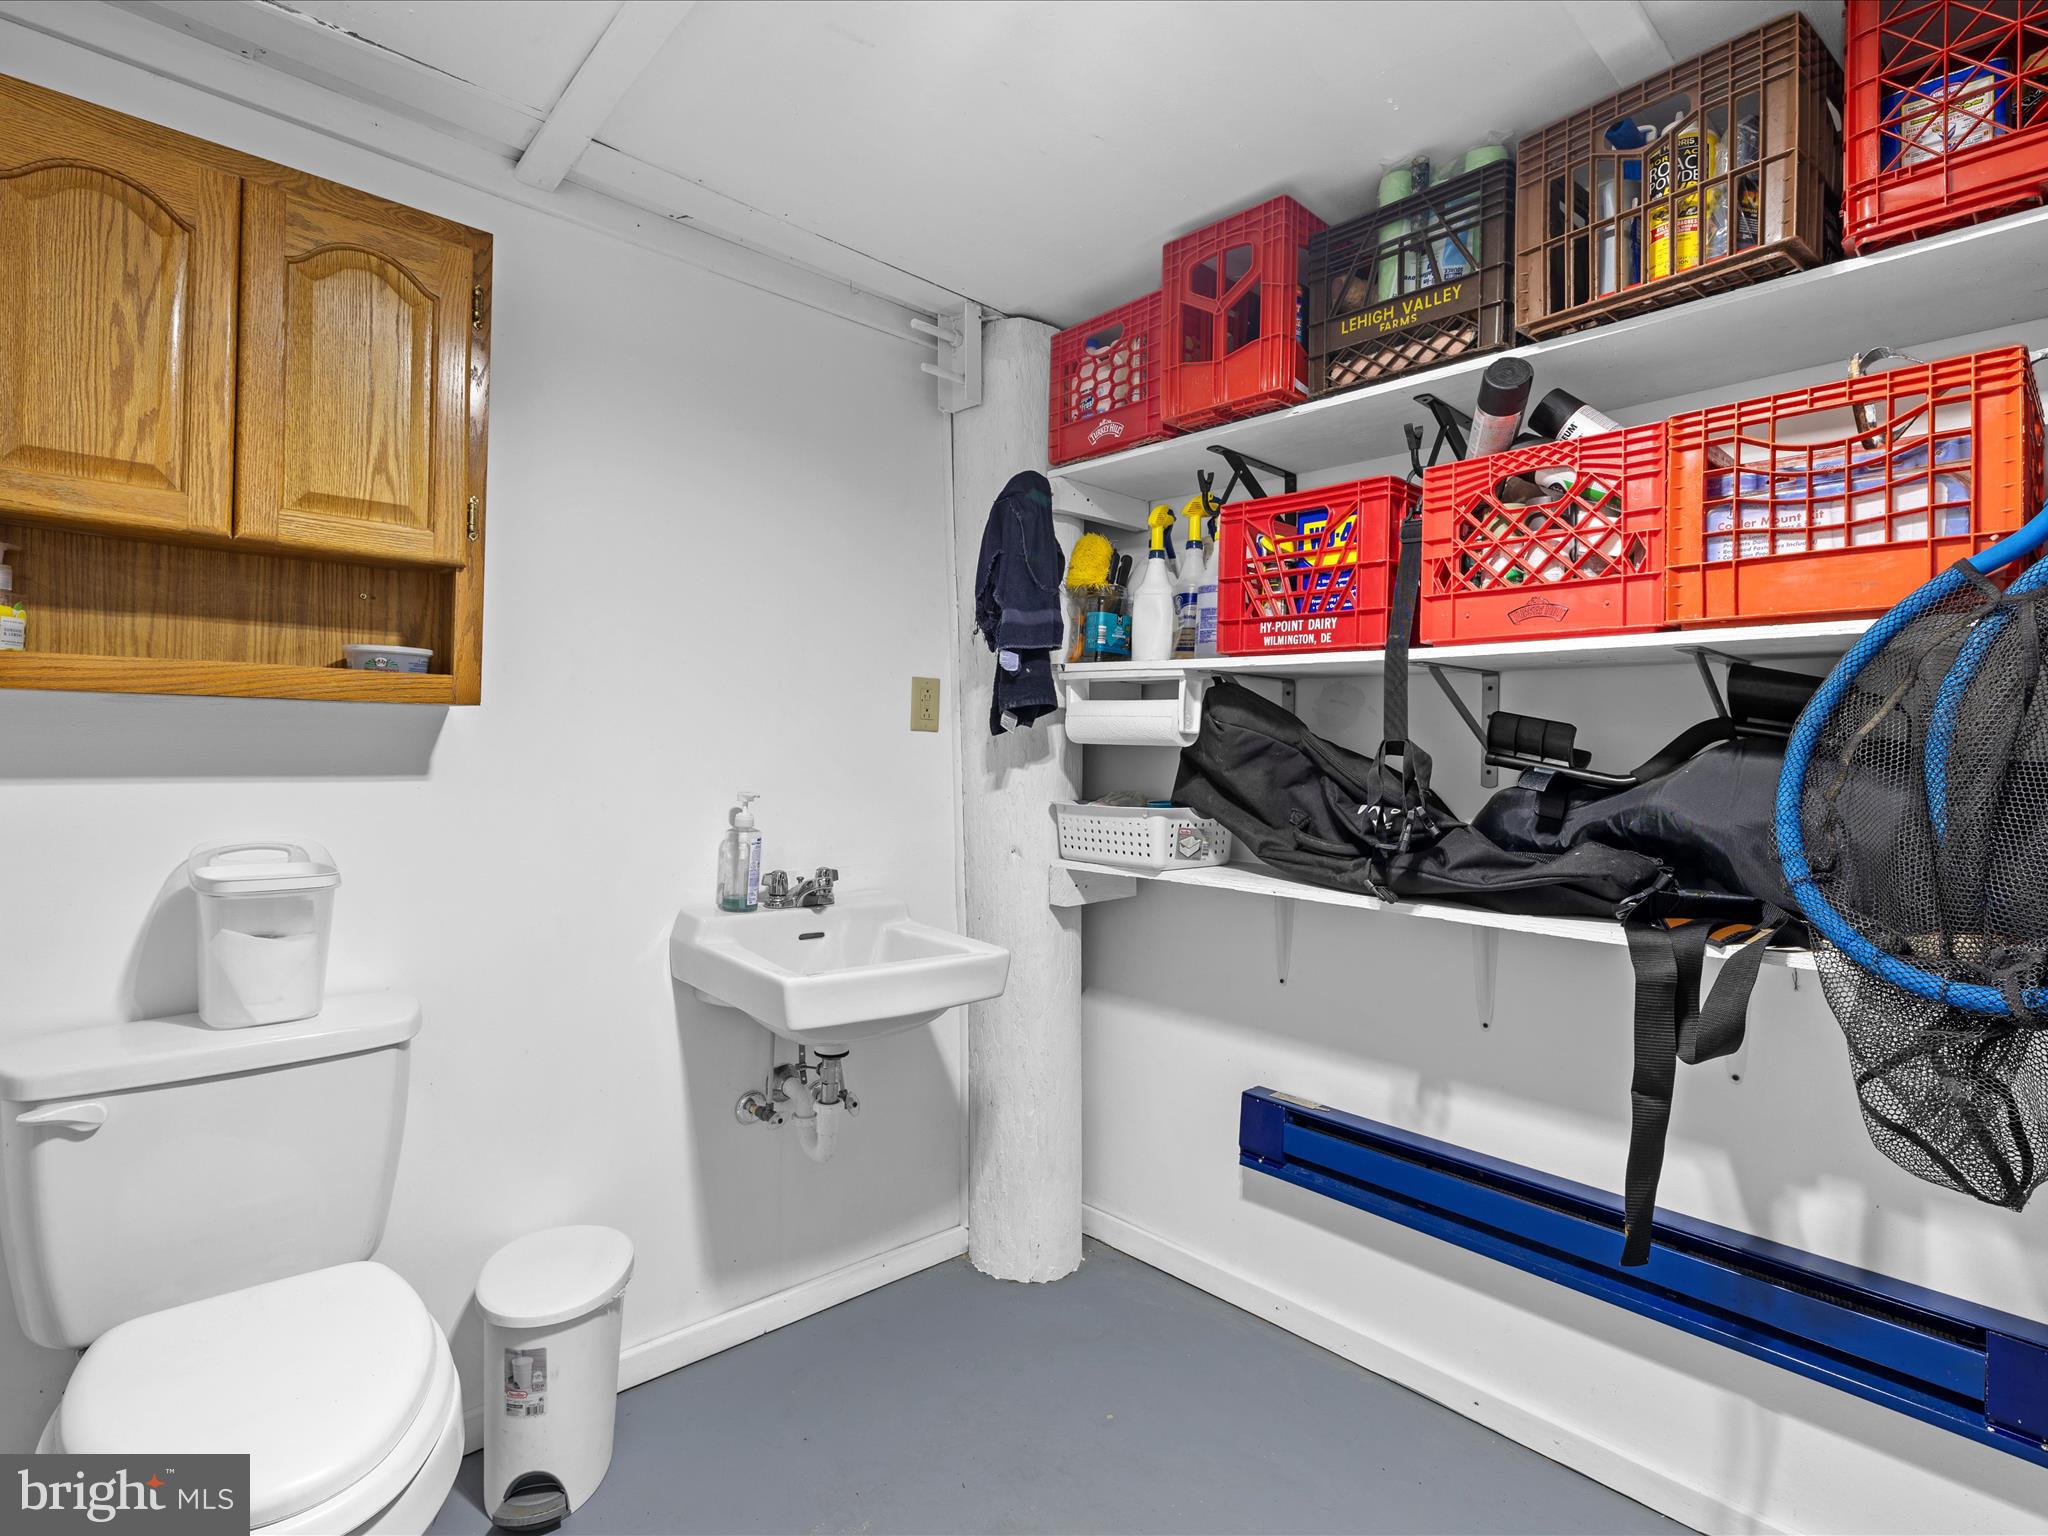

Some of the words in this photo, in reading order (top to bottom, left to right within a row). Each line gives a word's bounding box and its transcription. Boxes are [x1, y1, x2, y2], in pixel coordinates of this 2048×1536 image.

[1341, 306, 1394, 335] LEHIGH
[1402, 284, 1463, 315] VALLEY
[1379, 313, 1417, 332] FARMS
[1089, 424, 1111, 442] TURKEY
[1109, 422, 1122, 435] HILL
[1717, 520, 1757, 531] Coler
[1309, 521, 1357, 550] WD-4
[1260, 620, 1304, 634] HY-POINT
[1308, 617, 1338, 631] DAIRY
[1263, 633, 1317, 646] WILMINGTON,
[1320, 632, 1332, 643] DE
